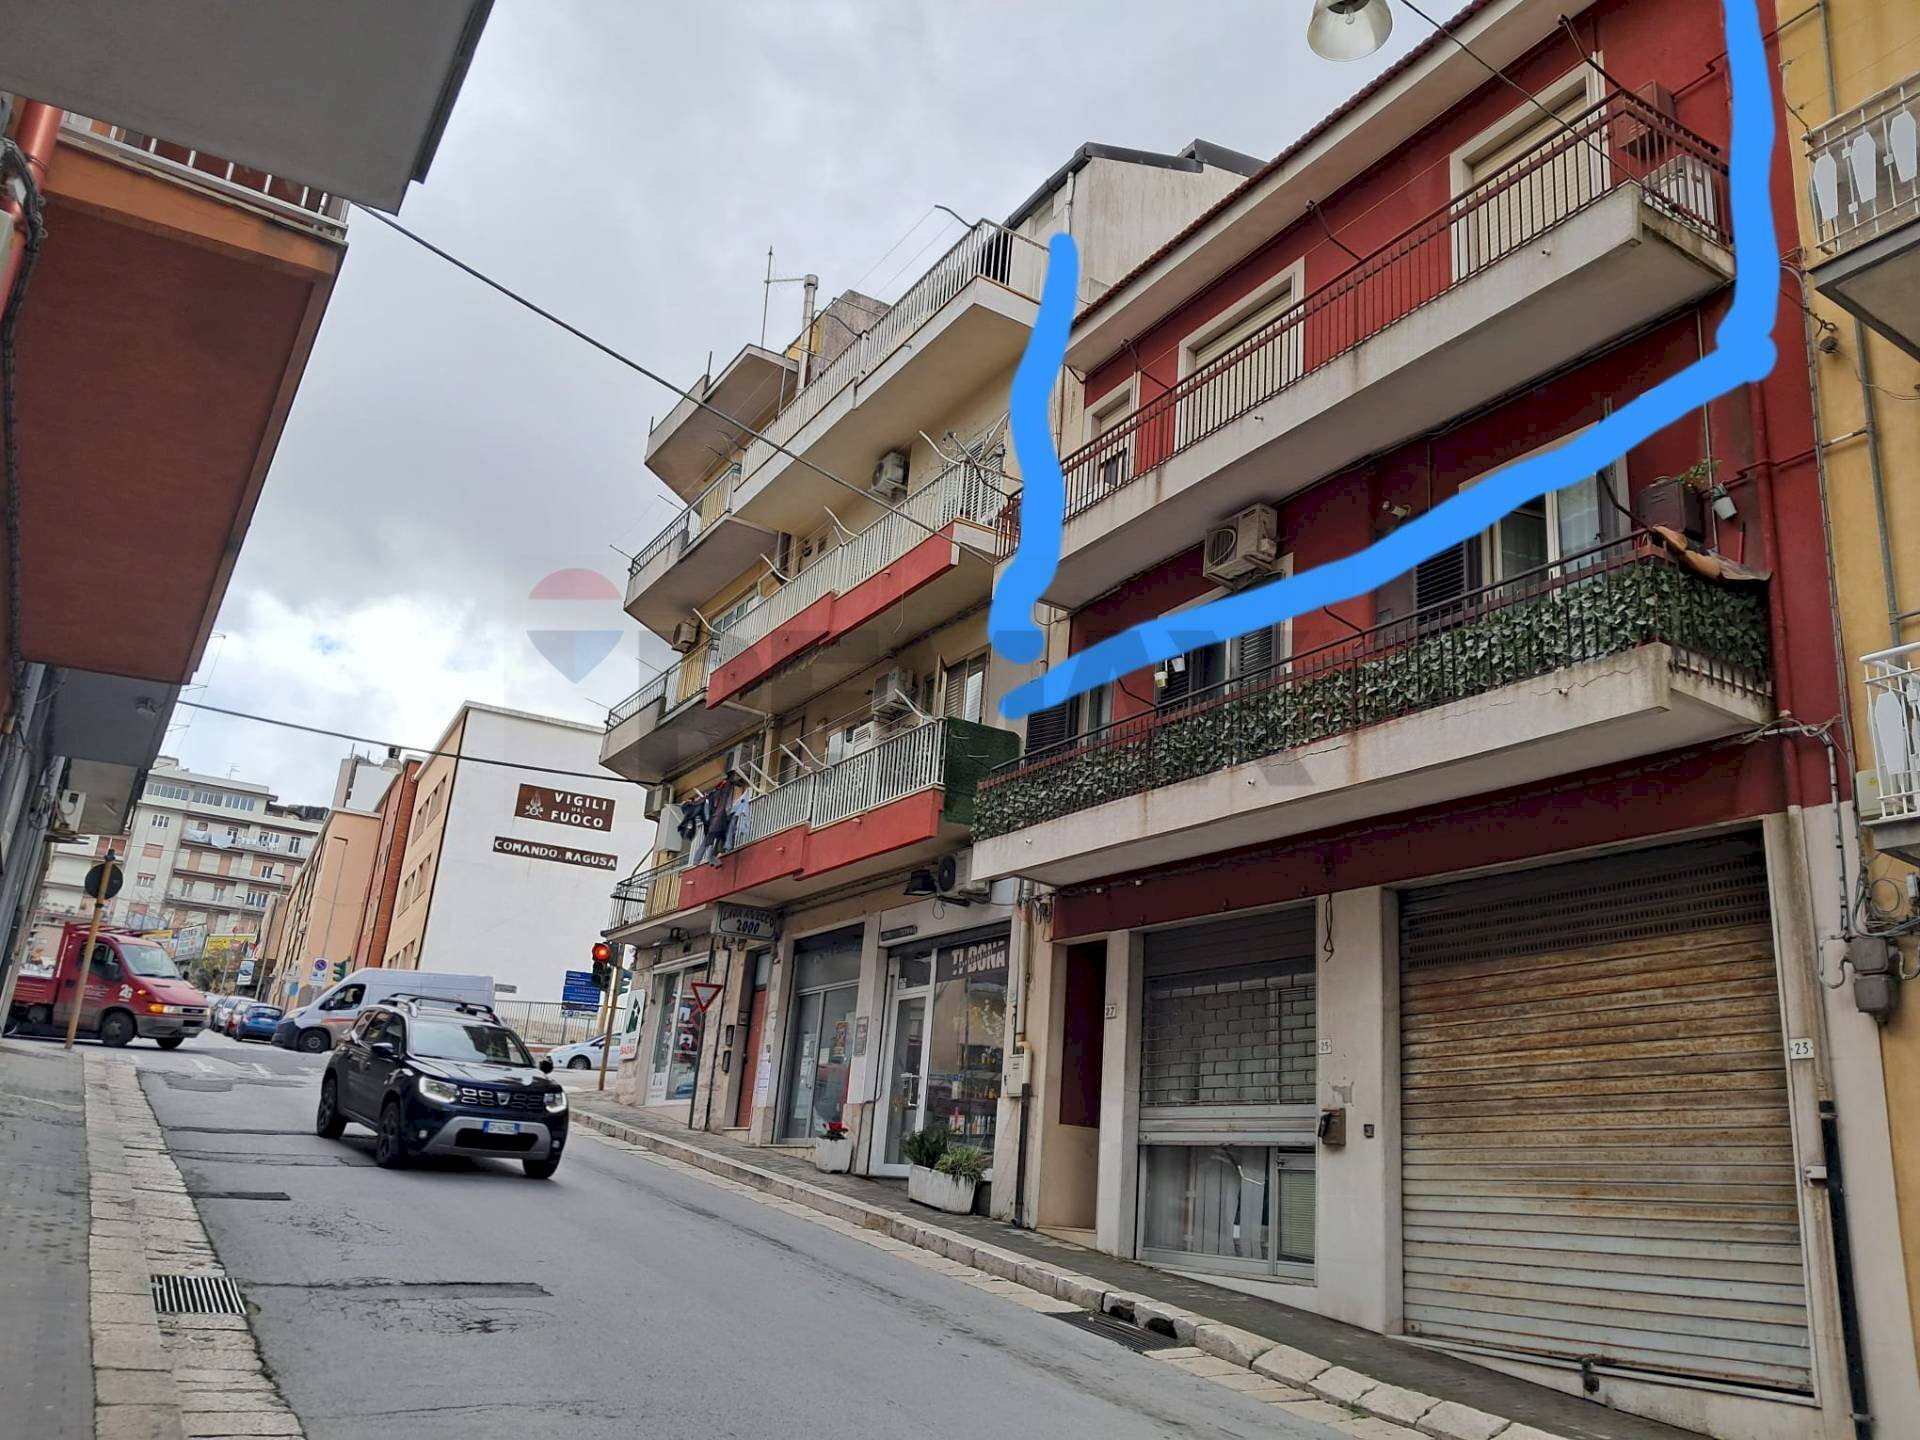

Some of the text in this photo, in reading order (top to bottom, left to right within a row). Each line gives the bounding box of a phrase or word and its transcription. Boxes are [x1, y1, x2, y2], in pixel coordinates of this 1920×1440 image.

[554, 791, 607, 811] VIGILI
[550, 810, 604, 828] FUOCO
[494, 839, 617, 868] COMANDO RAGUSA
[736, 919, 760, 934] 2000
[1105, 1006, 1115, 1017] 27
[1320, 1041, 1329, 1052] 25
[1794, 1042, 1809, 1055] 23
